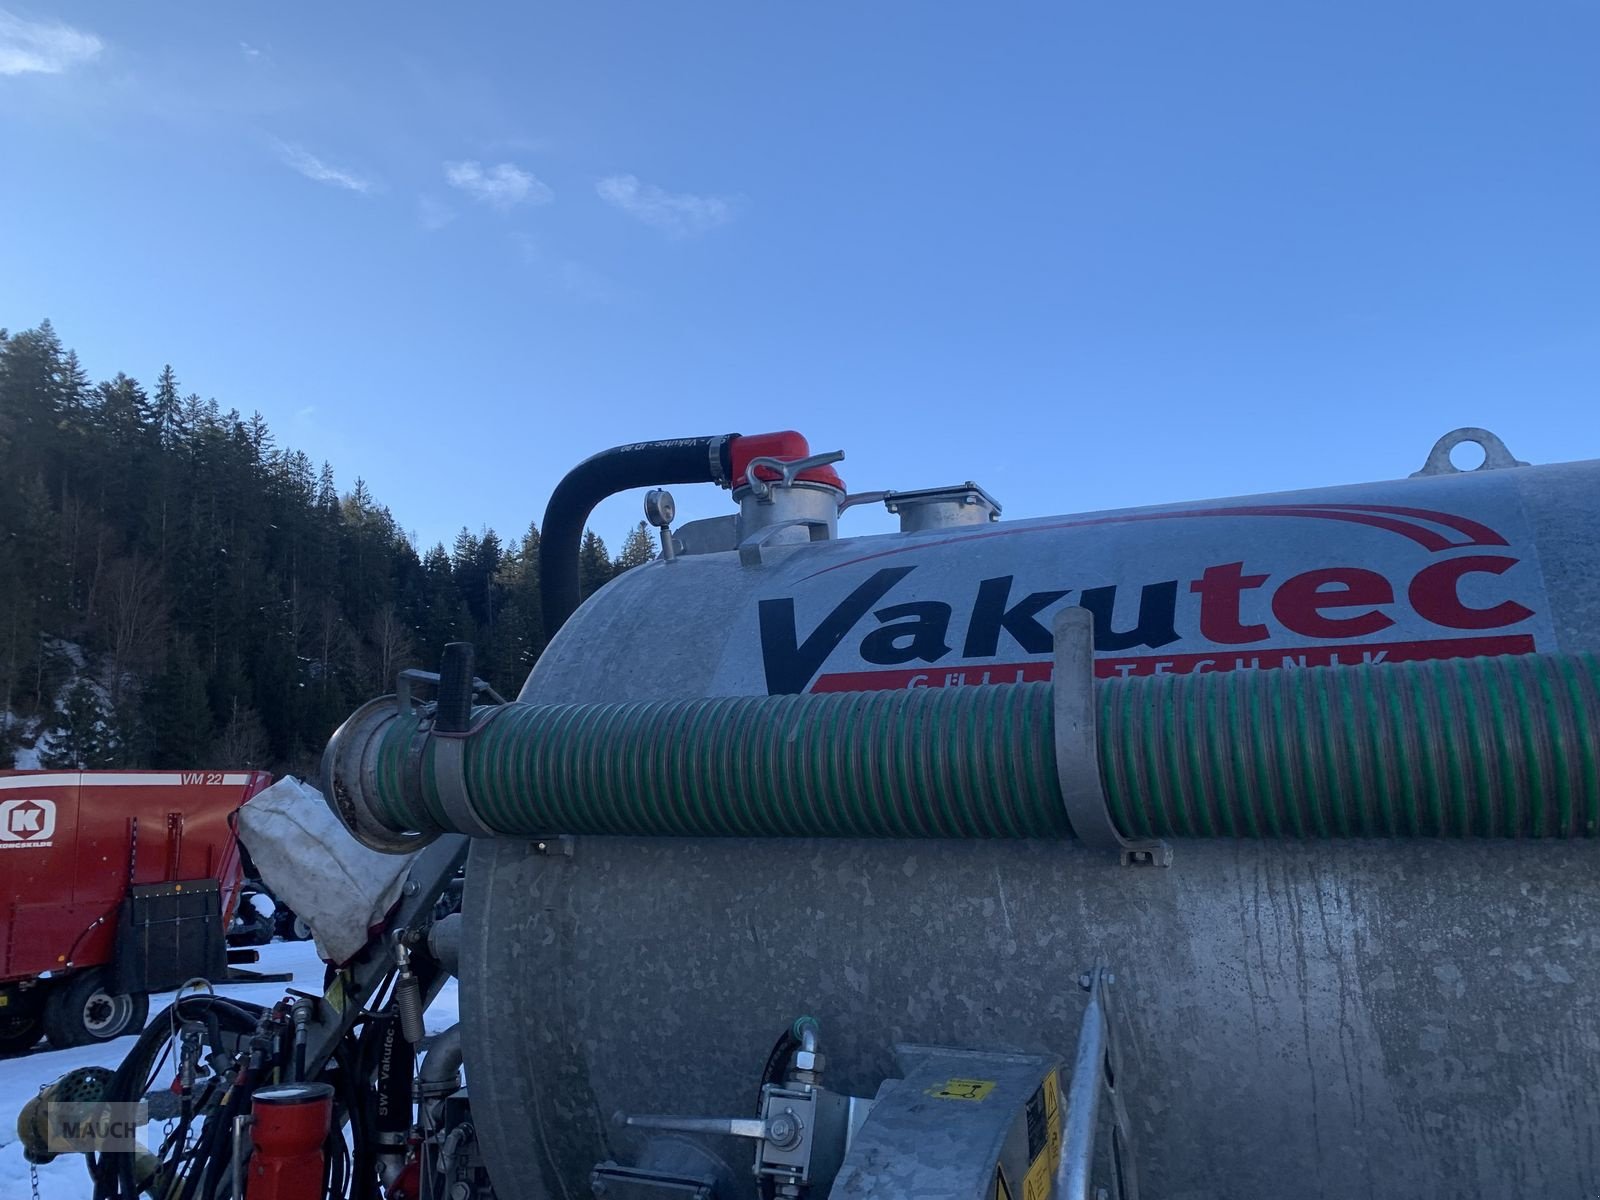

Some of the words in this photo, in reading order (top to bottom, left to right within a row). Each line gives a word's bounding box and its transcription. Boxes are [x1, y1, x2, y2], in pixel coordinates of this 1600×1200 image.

[655, 439, 697, 447] Vakutec
[758, 555, 1535, 696] Vakutec
[182, 773, 205, 785] VM
[206, 774, 222, 785] 22
[381, 1028, 395, 1080] Vakutec
